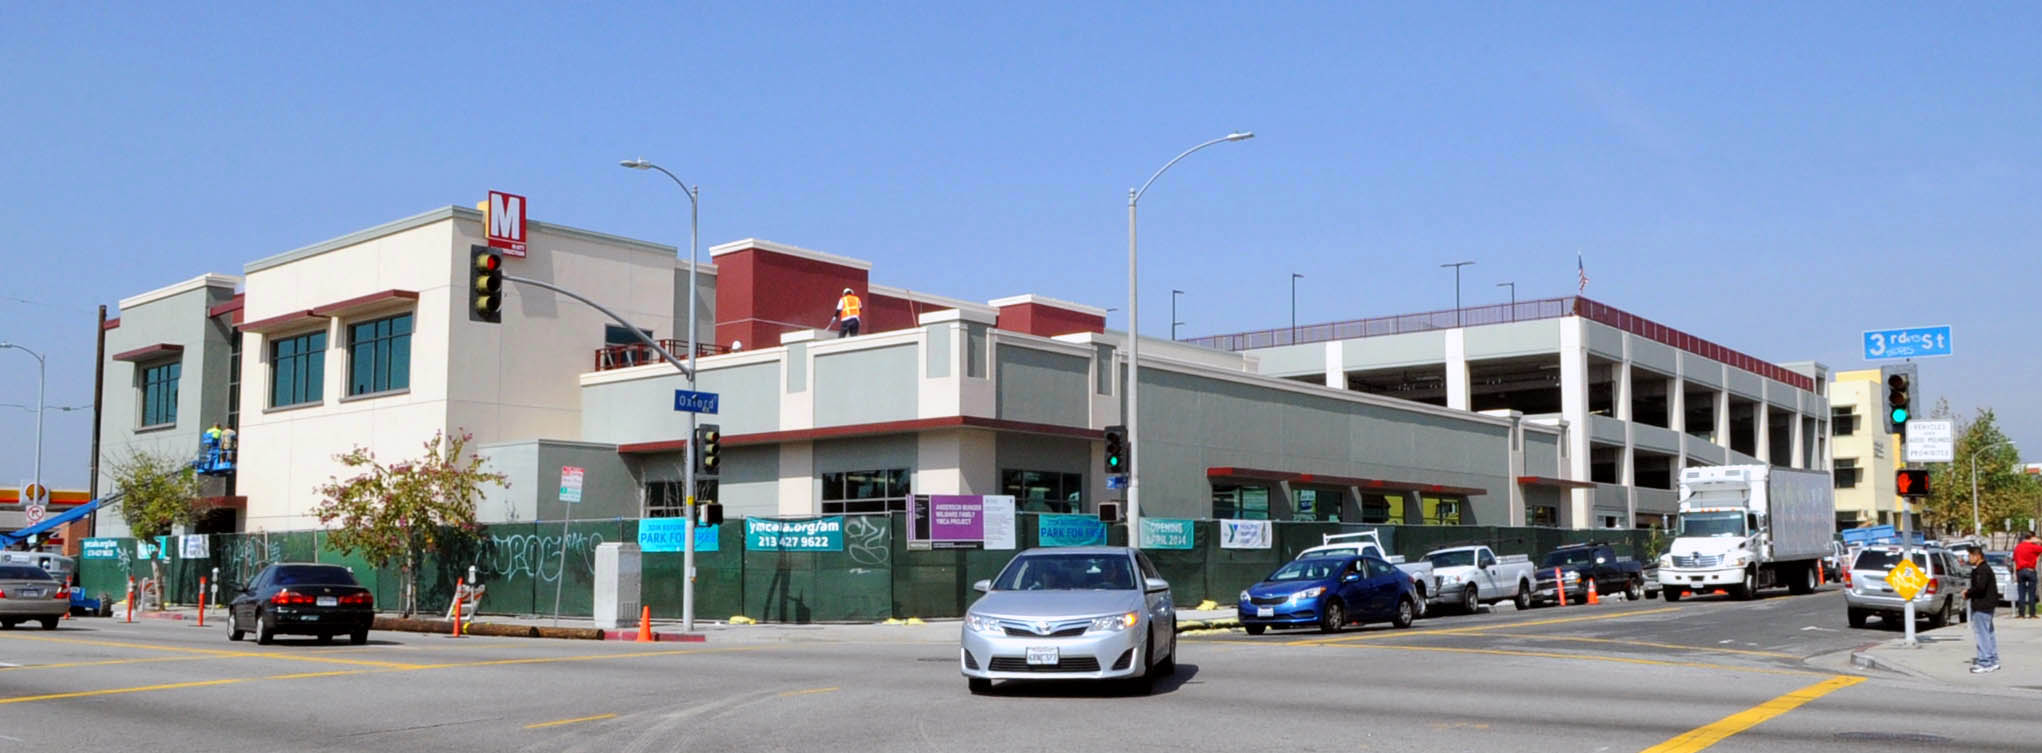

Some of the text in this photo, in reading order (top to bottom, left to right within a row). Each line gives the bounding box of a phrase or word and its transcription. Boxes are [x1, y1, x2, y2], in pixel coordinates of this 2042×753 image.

[491, 193, 520, 240] M
[1922, 333, 1945, 349] St
[749, 520, 839, 535] ymcala.org/am
[640, 532, 667, 544] PARK
[758, 536, 829, 547] 213 427 9622
